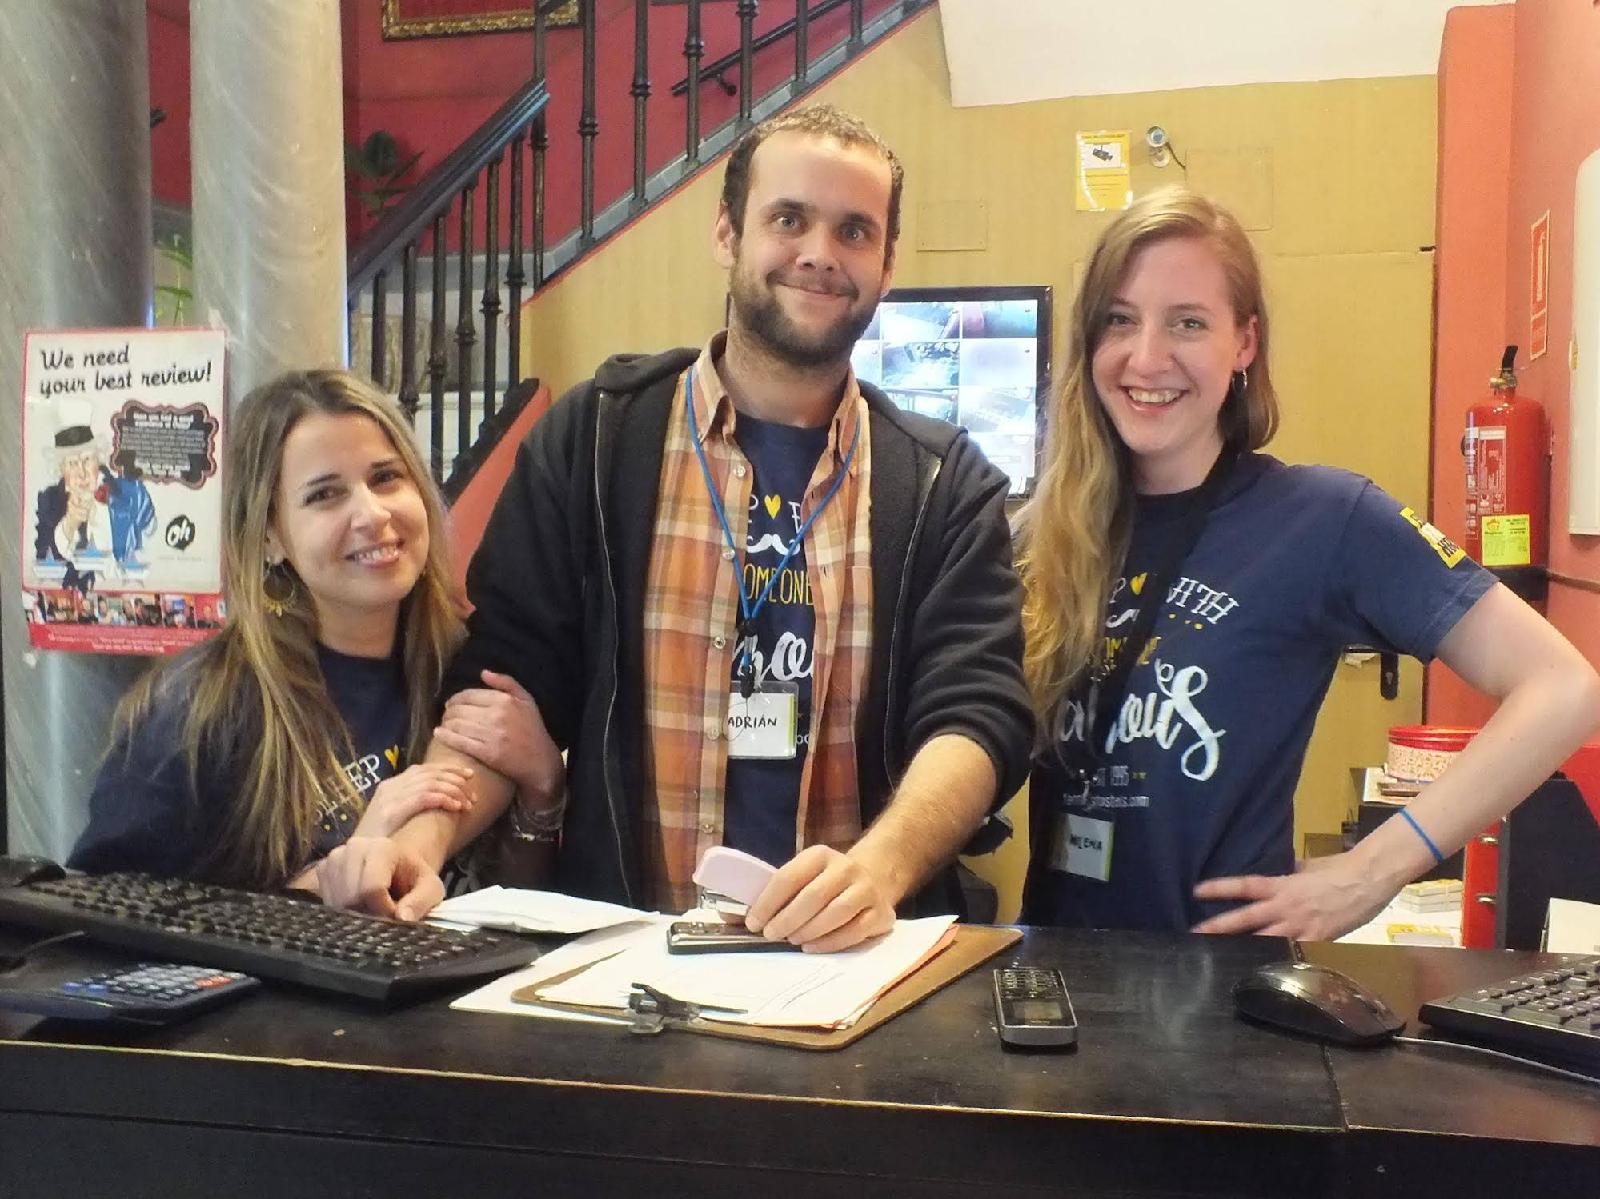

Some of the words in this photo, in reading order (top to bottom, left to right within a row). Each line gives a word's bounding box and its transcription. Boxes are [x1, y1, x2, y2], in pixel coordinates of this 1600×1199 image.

[40, 349, 74, 370] We
[83, 343, 130, 368] need
[40, 379, 86, 399] your
[95, 370, 132, 391] best
[141, 360, 212, 387] review!
